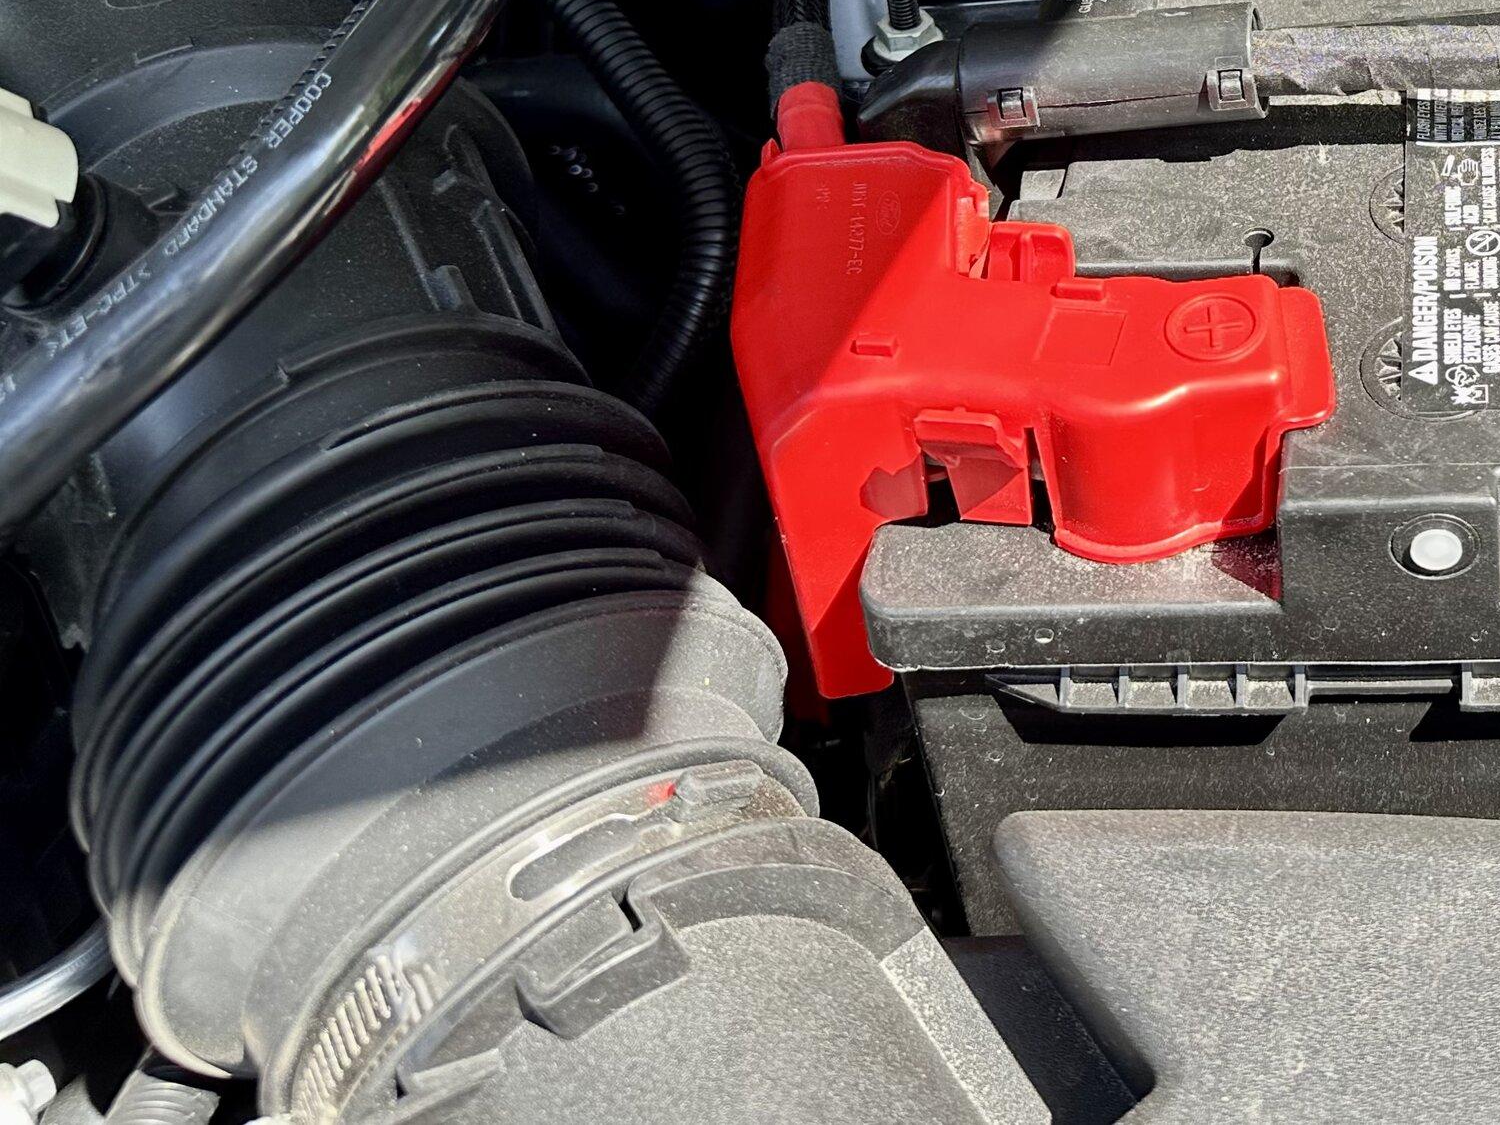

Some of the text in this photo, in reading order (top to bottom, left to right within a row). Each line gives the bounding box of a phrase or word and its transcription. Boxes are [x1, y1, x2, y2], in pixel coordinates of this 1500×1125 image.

[263, 73, 332, 148] COOPER
[1417, 101, 1430, 118] EYES
[1417, 118, 1431, 140] FLUSH
[1435, 124, 1447, 141] WITH
[163, 156, 259, 257] STANDARD
[1444, 186, 1462, 225] SULFURIC
[1479, 147, 1498, 223] CAN CAUSE BLINDNESS
[1463, 205, 1479, 224] ACID
[1444, 279, 1461, 290] NO
[1483, 257, 1499, 289] SMOKING
[1412, 237, 1440, 361] DANGER/POISON
[1444, 308, 1462, 364] SHIELD EYES
[1463, 315, 1481, 363] EXPLOSIVE
[1483, 301, 1500, 373] GASES CAN CAUSE
